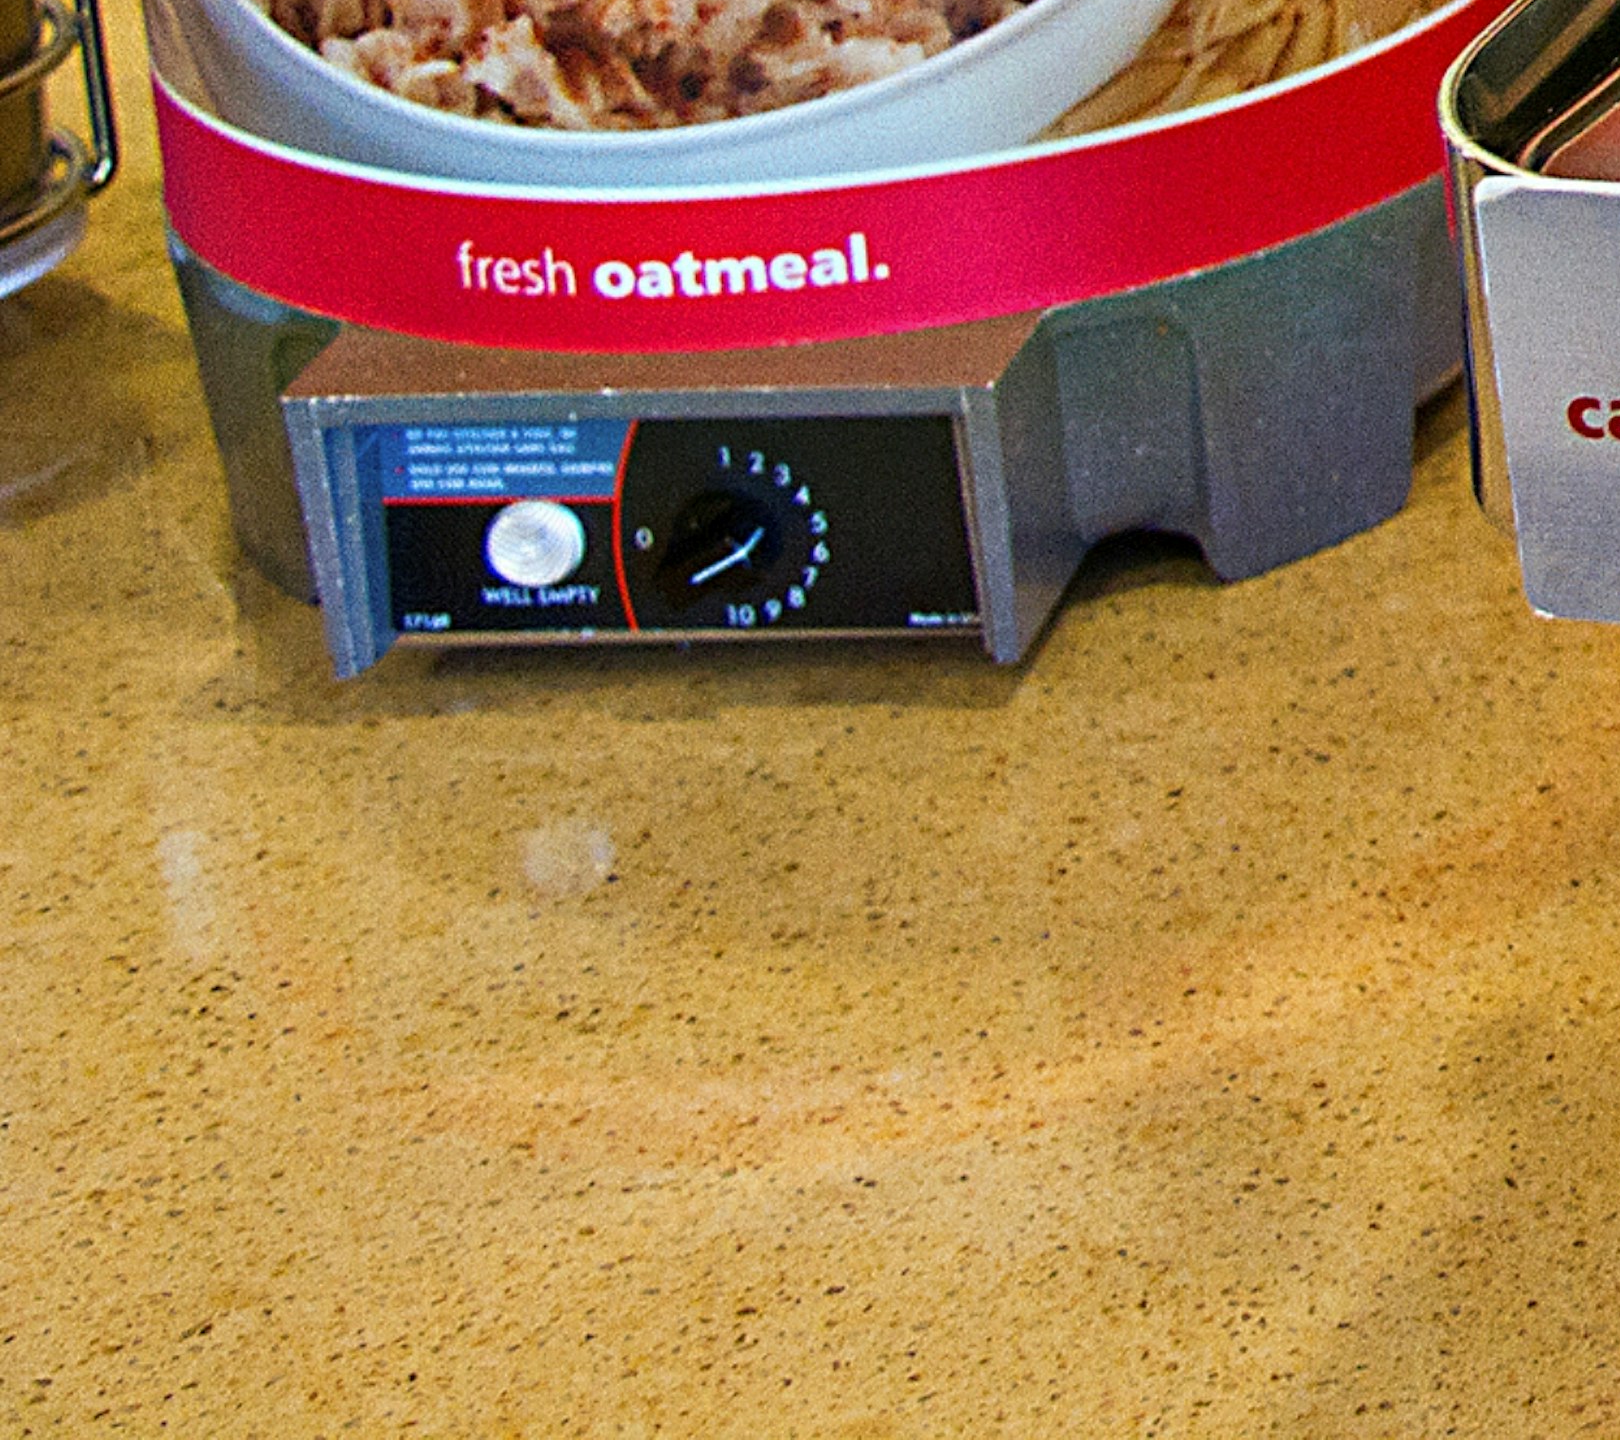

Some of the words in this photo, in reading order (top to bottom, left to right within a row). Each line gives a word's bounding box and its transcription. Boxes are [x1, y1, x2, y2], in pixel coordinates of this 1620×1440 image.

[457, 239, 577, 296] fresh
[592, 231, 890, 299] oatmeal.
[718, 446, 731, 468] 1
[748, 450, 765, 475] 2
[774, 462, 791, 487] 3
[792, 485, 811, 506] 4
[809, 510, 829, 536] 5
[633, 526, 654, 550] 0
[811, 539, 831, 564] 6
[802, 566, 819, 588] 7
[481, 585, 532, 606] WELL
[786, 584, 806, 610] 8
[723, 603, 756, 627] 10
[762, 598, 782, 623] 9
